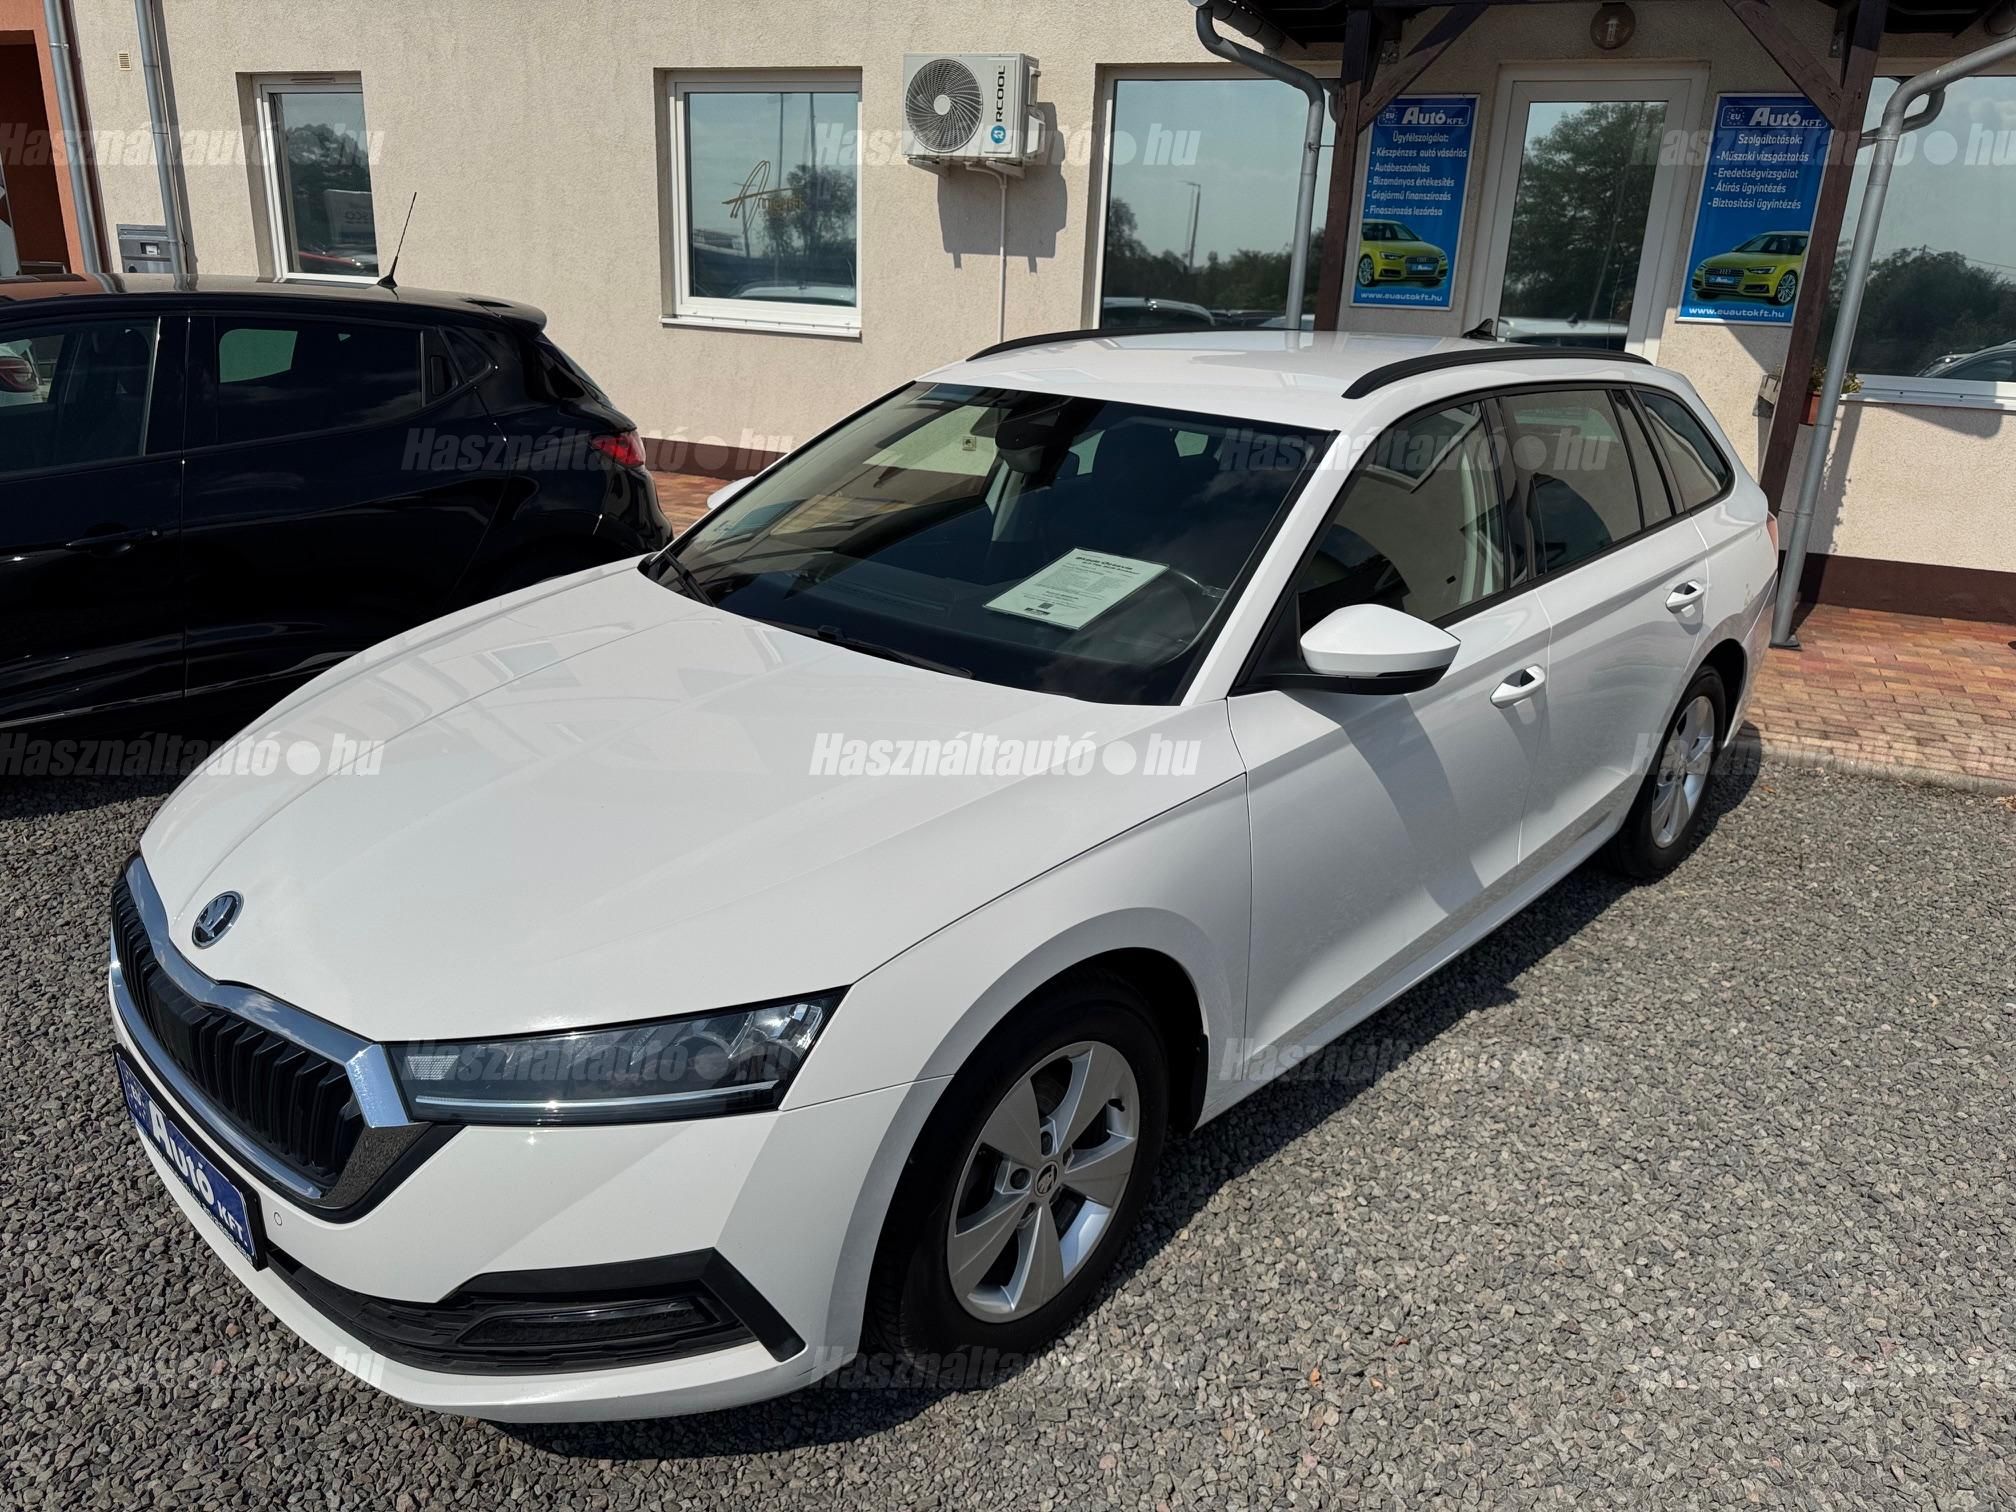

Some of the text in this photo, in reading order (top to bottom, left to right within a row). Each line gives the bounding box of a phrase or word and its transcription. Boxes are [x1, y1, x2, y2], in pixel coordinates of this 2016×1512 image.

[995, 65, 1006, 122] RCOOL
[1402, 106, 1446, 125] Autó
[1446, 117, 1464, 125] KFT.
[1749, 107, 1801, 126] Autó
[1802, 119, 1822, 127] KFT.
[1392, 130, 1449, 144] Ügyfélszolgálat:
[1737, 134, 1803, 146] Szolgáltatások:
[1376, 147, 1417, 158] Készpénzes
[1419, 149, 1436, 157] autó
[1437, 149, 1467, 158] vásárlás
[1756, 151, 1809, 163] vizsgáztatás
[1742, 183, 1786, 194] ügyintézés
[1757, 199, 1801, 210] ügyintézés
[1360, 291, 1443, 302] www.euautokft.hu
[1688, 307, 1785, 318] www.euautokft.hu
[148, 1099, 215, 1206] Autó
